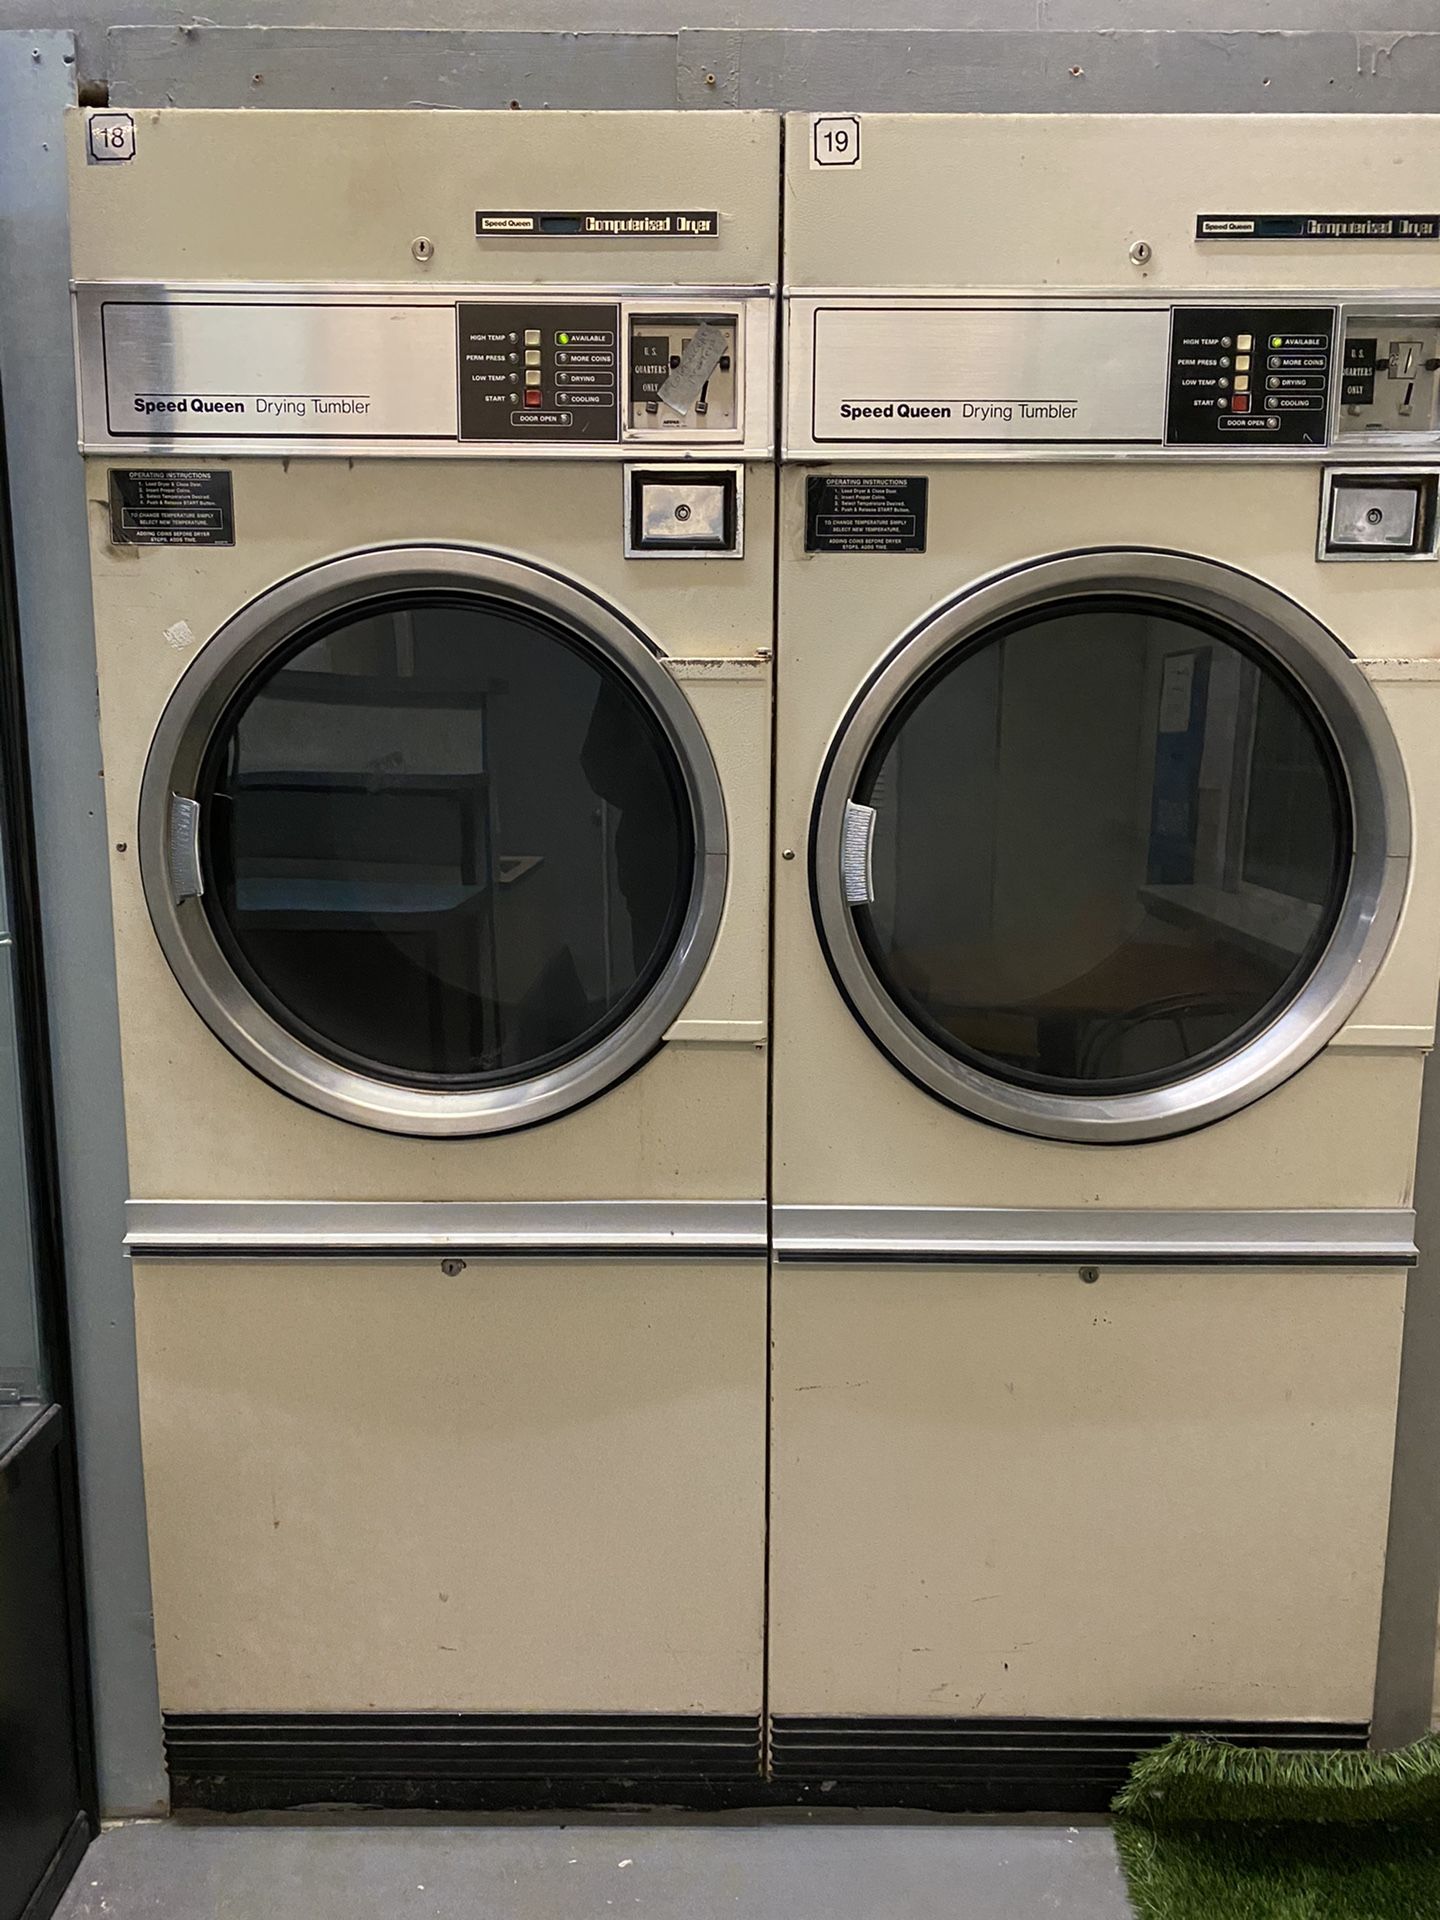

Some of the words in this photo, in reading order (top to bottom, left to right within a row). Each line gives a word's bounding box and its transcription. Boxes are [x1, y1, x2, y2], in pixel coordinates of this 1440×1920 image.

[100, 128, 124, 148] 18
[824, 130, 848, 152] 19
[484, 220, 506, 228] Speed
[676, 217, 712, 234] Dryer
[1205, 222, 1228, 231] Speed
[1229, 222, 1252, 230] Queen
[1400, 220, 1434, 236] Dryer
[634, 365, 667, 374] QUARTERS
[642, 383, 659, 392] ONLY
[1347, 385, 1364, 395] ONLY
[134, 398, 188, 414] Speed
[191, 398, 244, 413] Queen
[256, 399, 306, 416] Drying
[313, 400, 370, 414] Tumbler
[840, 404, 894, 420] Speed
[897, 404, 951, 418] Queen
[962, 404, 1012, 421] Drying
[1018, 404, 1078, 418] Tumbler
